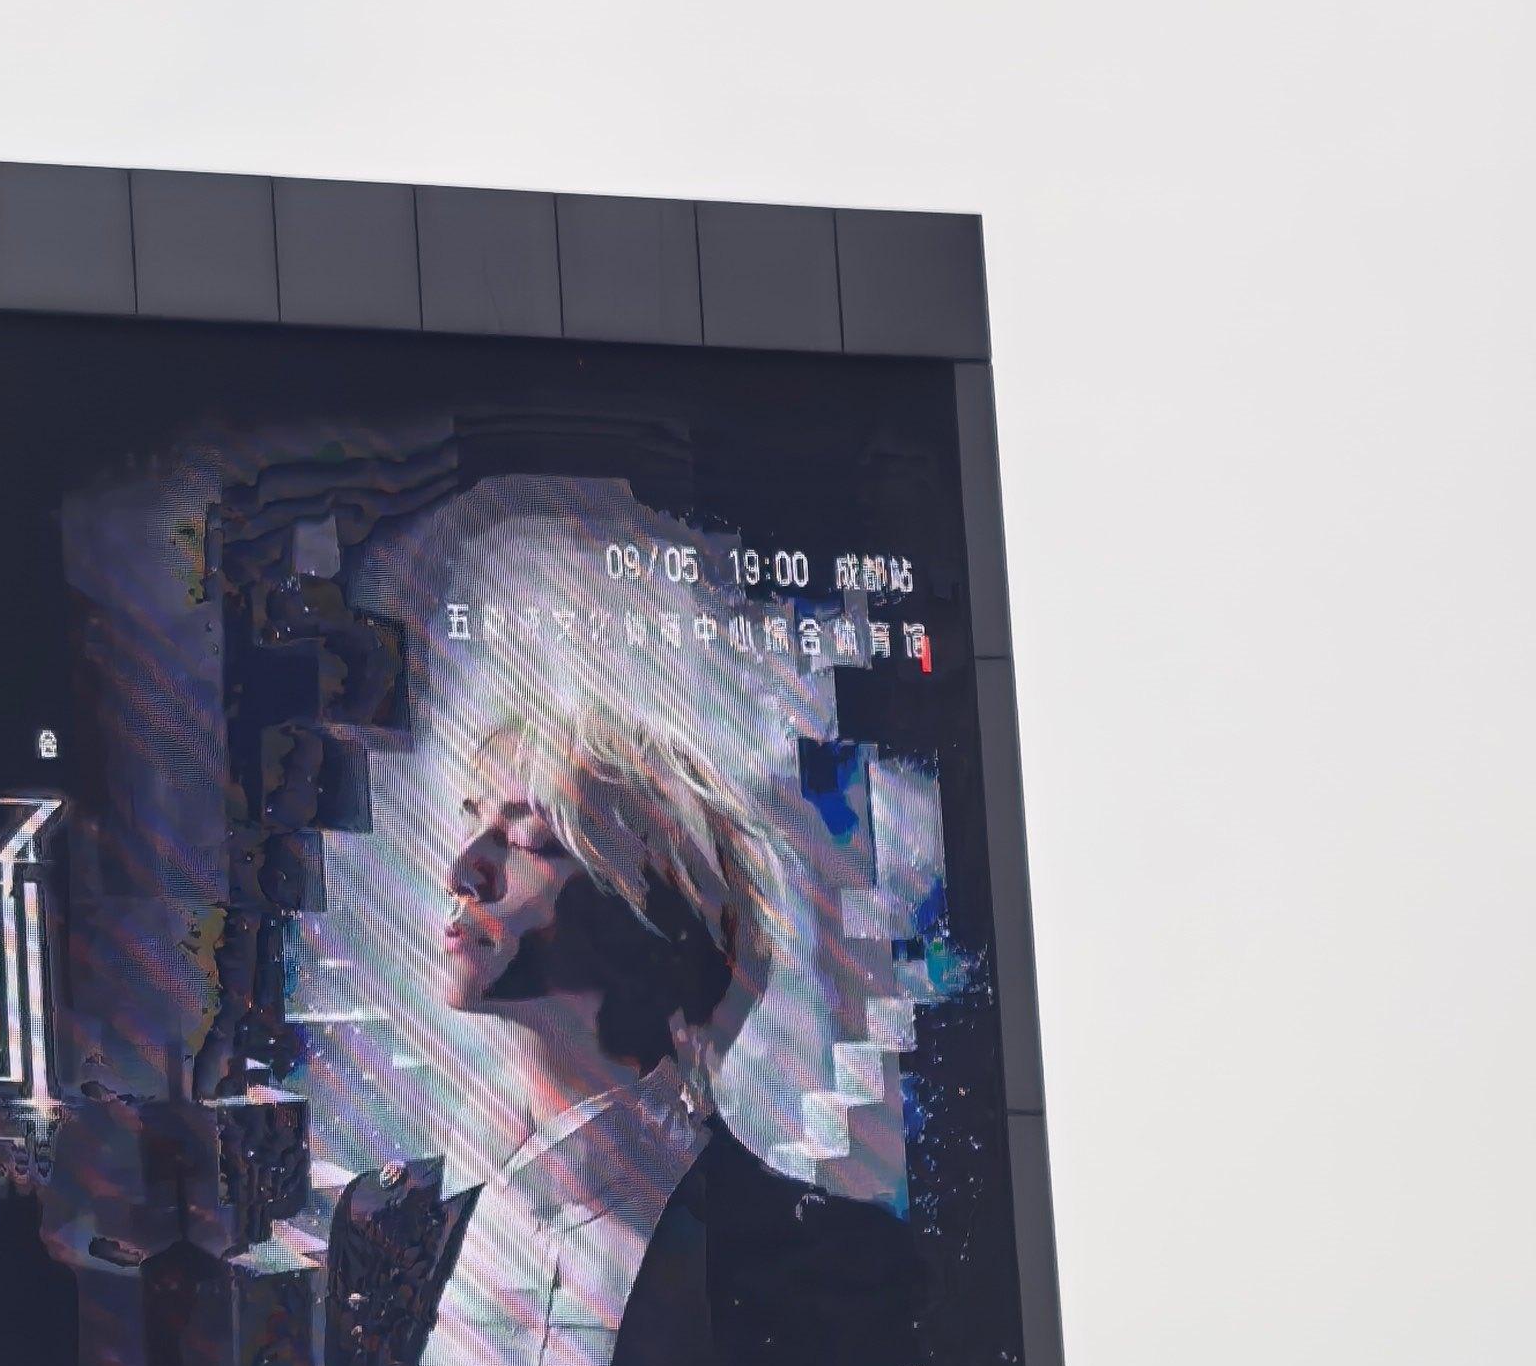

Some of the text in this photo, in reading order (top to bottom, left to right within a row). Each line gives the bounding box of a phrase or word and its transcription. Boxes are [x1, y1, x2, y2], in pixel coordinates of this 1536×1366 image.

[606, 543, 914, 593] 09/05 19:00 成都站
[447, 602, 927, 659] 五文化中心综合体育馆
